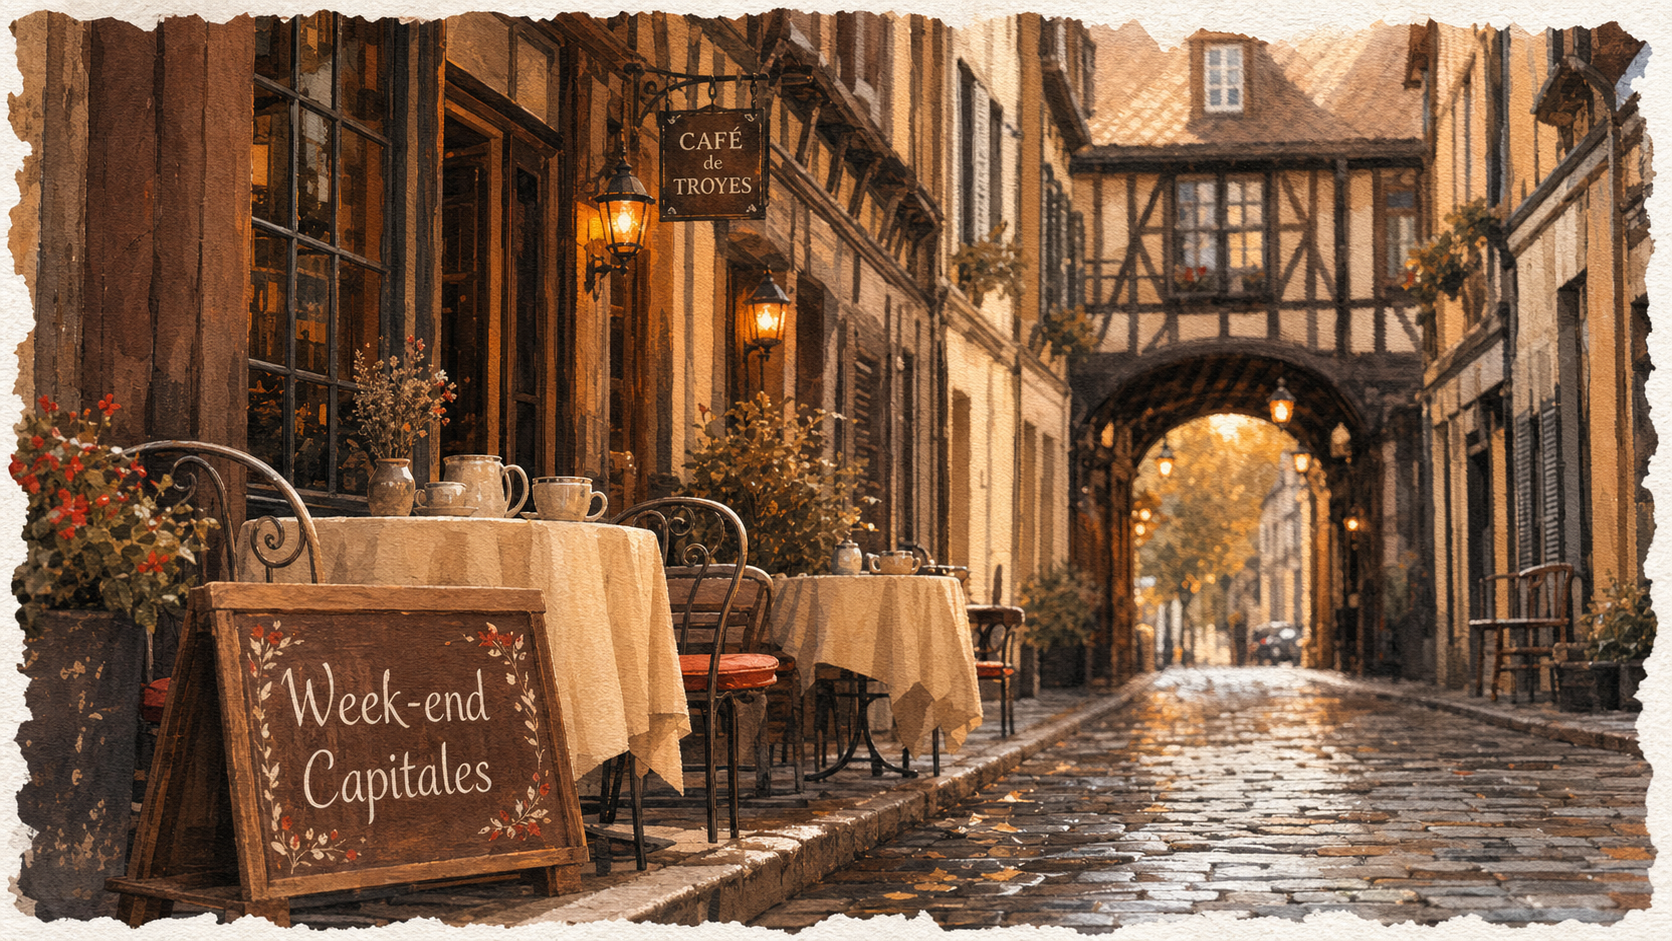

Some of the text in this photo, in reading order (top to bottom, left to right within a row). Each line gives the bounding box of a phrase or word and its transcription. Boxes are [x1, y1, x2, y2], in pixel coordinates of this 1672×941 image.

[679, 126, 743, 151] CAFÉ
[703, 155, 723, 171] de
[673, 176, 752, 197] TROYES
[281, 662, 490, 729] Week-end
[303, 742, 493, 825] Capitales
